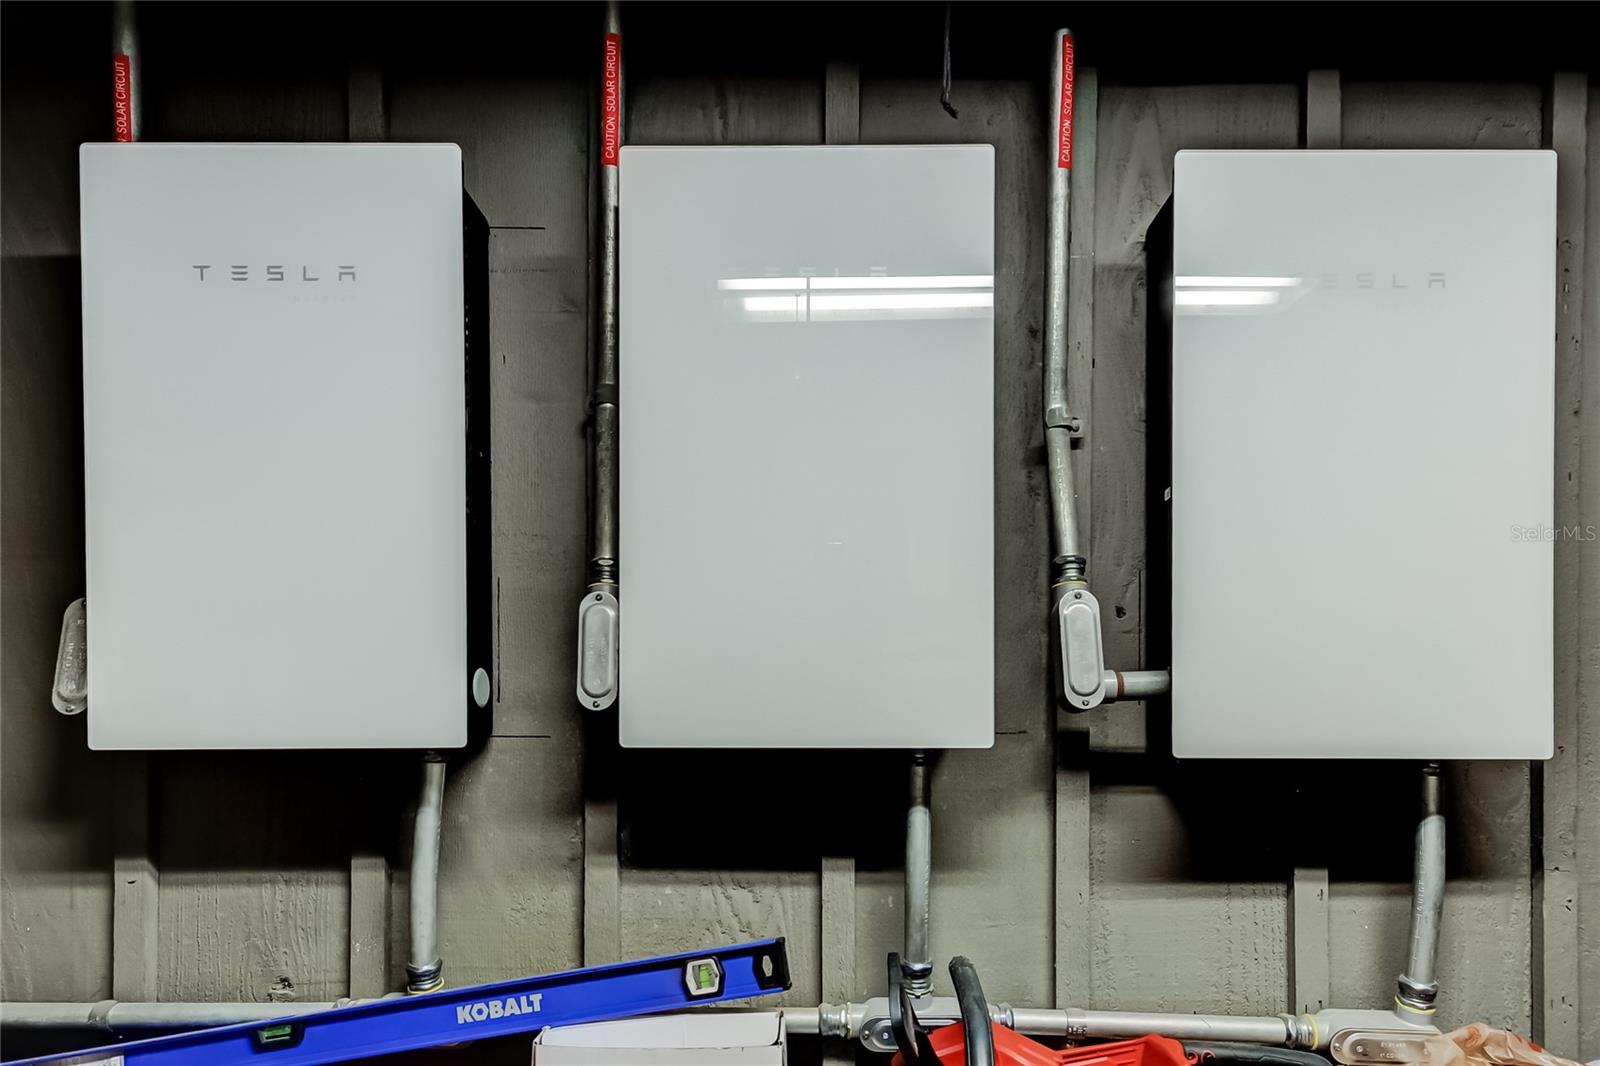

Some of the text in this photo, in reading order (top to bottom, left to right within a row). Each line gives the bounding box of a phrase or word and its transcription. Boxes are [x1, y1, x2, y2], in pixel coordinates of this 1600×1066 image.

[606, 40, 617, 79] CIRCUIT
[1065, 41, 1074, 80] CIRCUIT
[115, 61, 126, 99] CIRCUIT
[606, 80, 616, 112] SOLAR
[1064, 83, 1073, 115] SOLAR
[116, 101, 127, 133] SOLAR
[192, 265, 356, 281] TESLA
[1320, 272, 1446, 289] ESLA
[456, 993, 543, 1025] KOBALT
